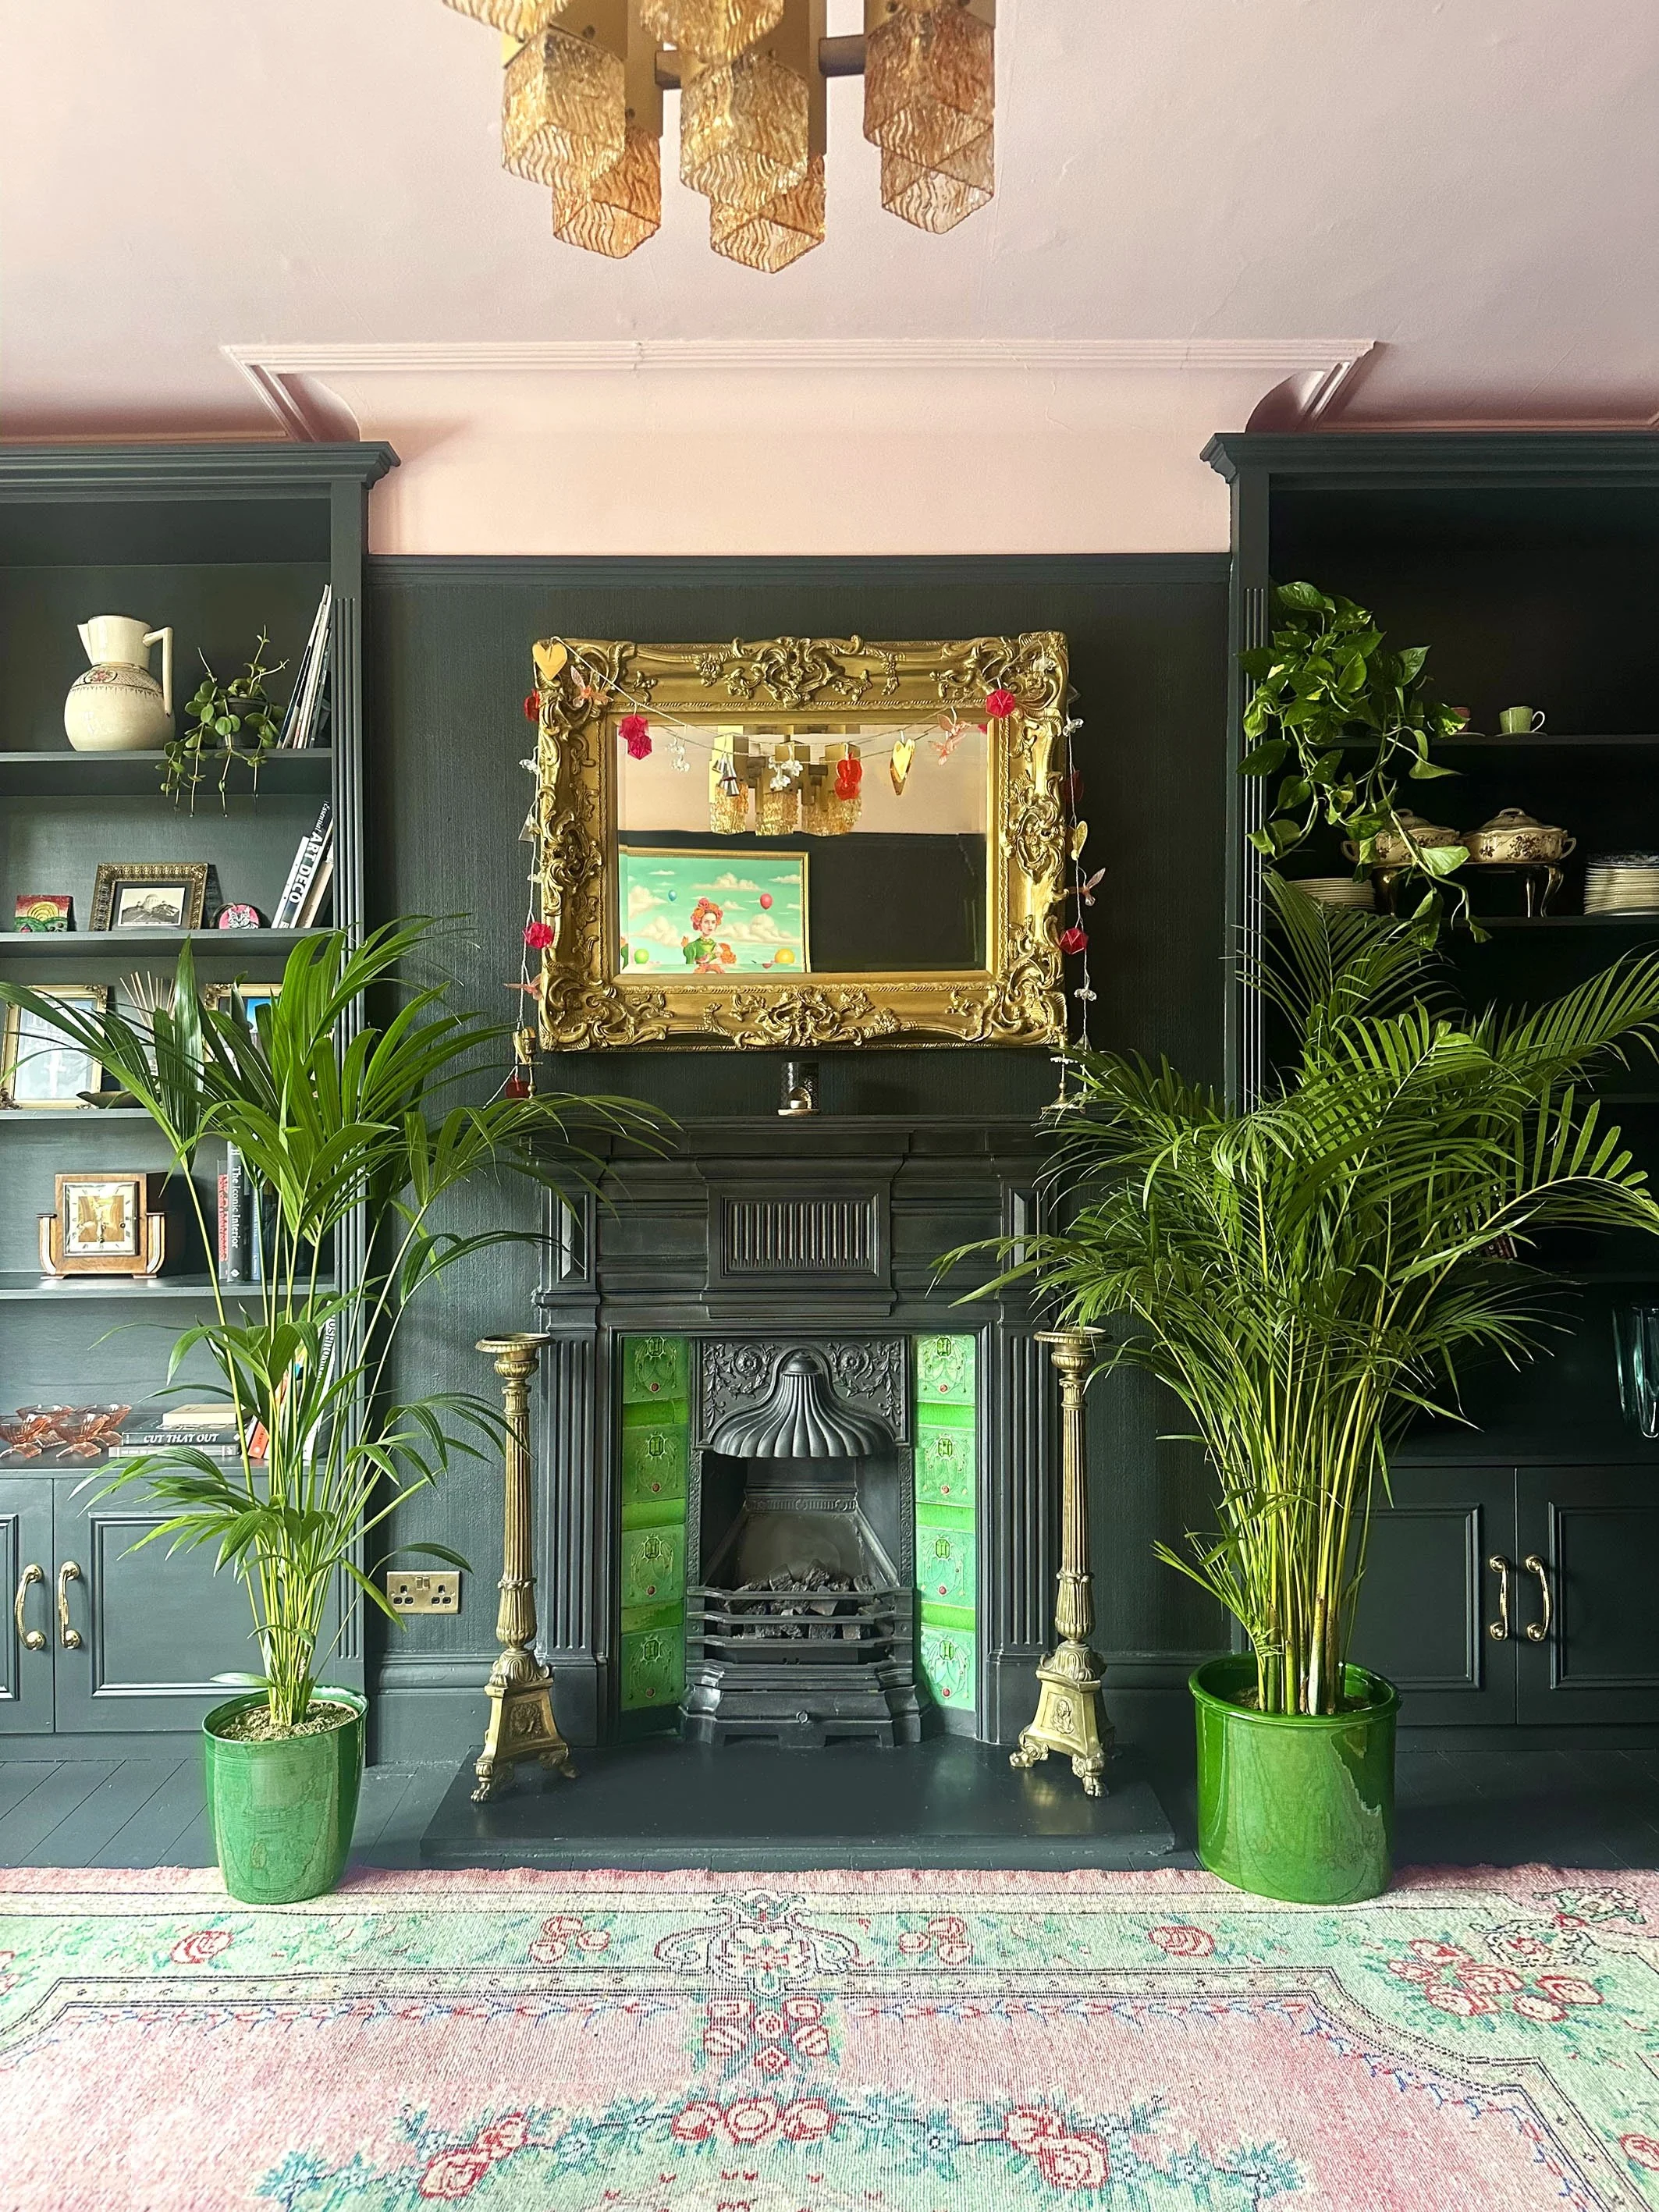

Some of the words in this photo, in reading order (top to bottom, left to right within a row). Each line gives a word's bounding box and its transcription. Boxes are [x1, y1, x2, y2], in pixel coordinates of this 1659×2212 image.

[314, 803, 331, 833] Essential
[304, 831, 323, 861] ART
[289, 863, 312, 904] DECO
[232, 1165, 241, 1184] The
[232, 1185, 241, 1213] Iconic
[231, 1214, 240, 1248] Interior
[143, 1434, 165, 1443] CUT
[166, 1433, 195, 1443] THAT
[196, 1433, 219, 1443] OUT
